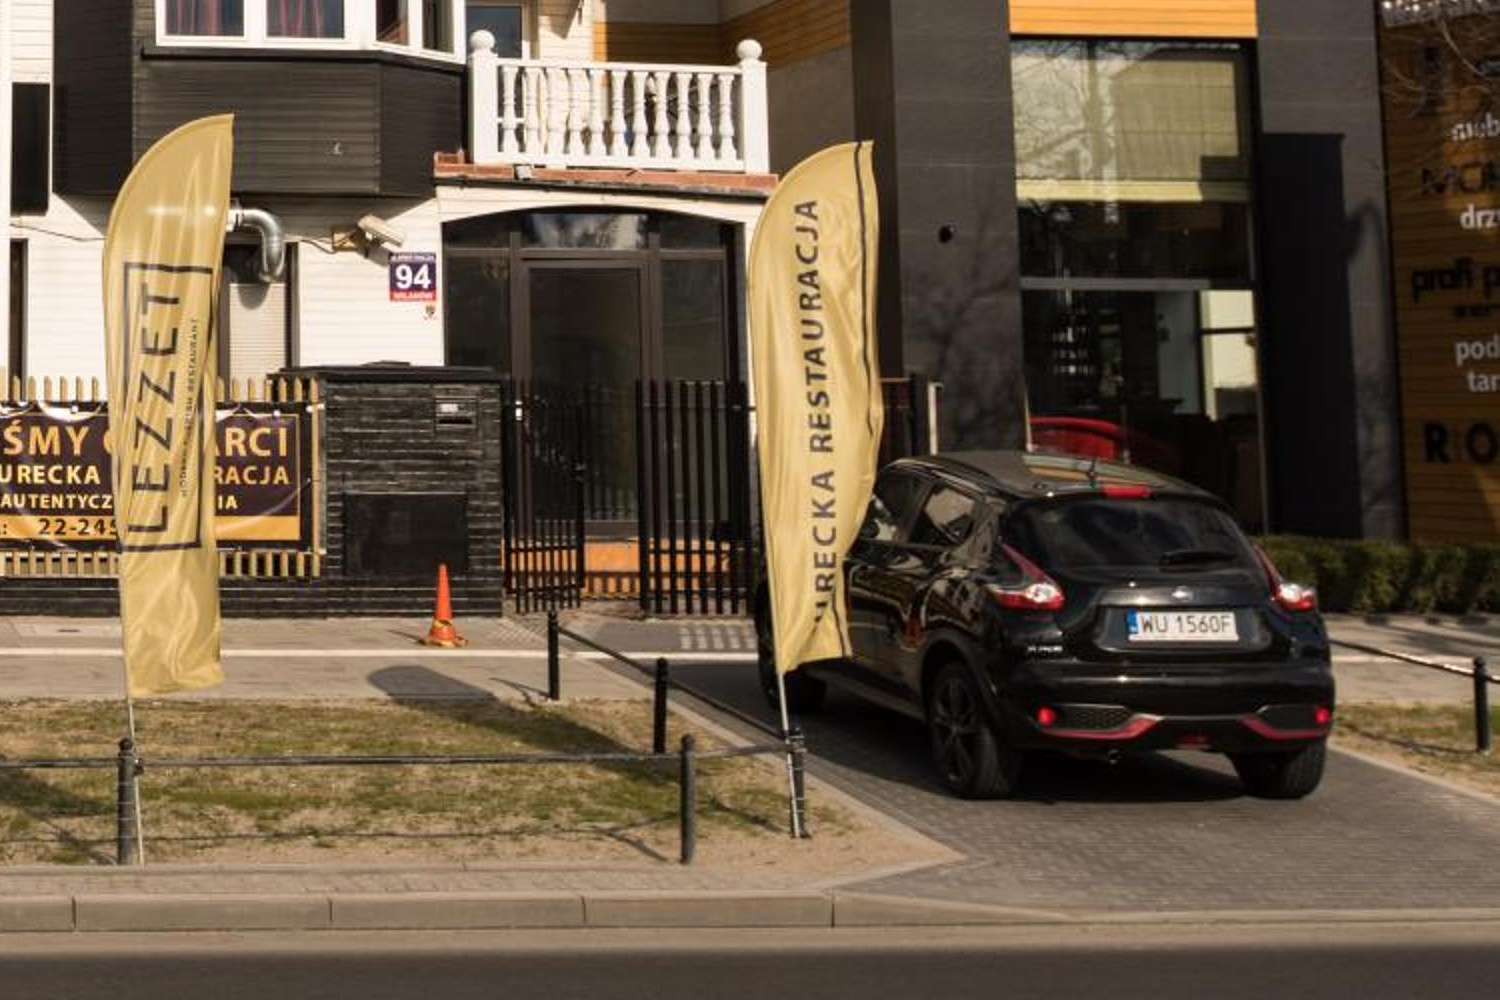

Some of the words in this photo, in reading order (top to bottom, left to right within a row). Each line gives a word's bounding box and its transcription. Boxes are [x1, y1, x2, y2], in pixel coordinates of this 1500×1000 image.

[395, 264, 431, 289] 94
[794, 200, 834, 453] RESTAURACJA
[128, 281, 180, 532] LEZZET
[1141, 615, 1169, 633] WU
[1176, 615, 1231, 633] 1560F
